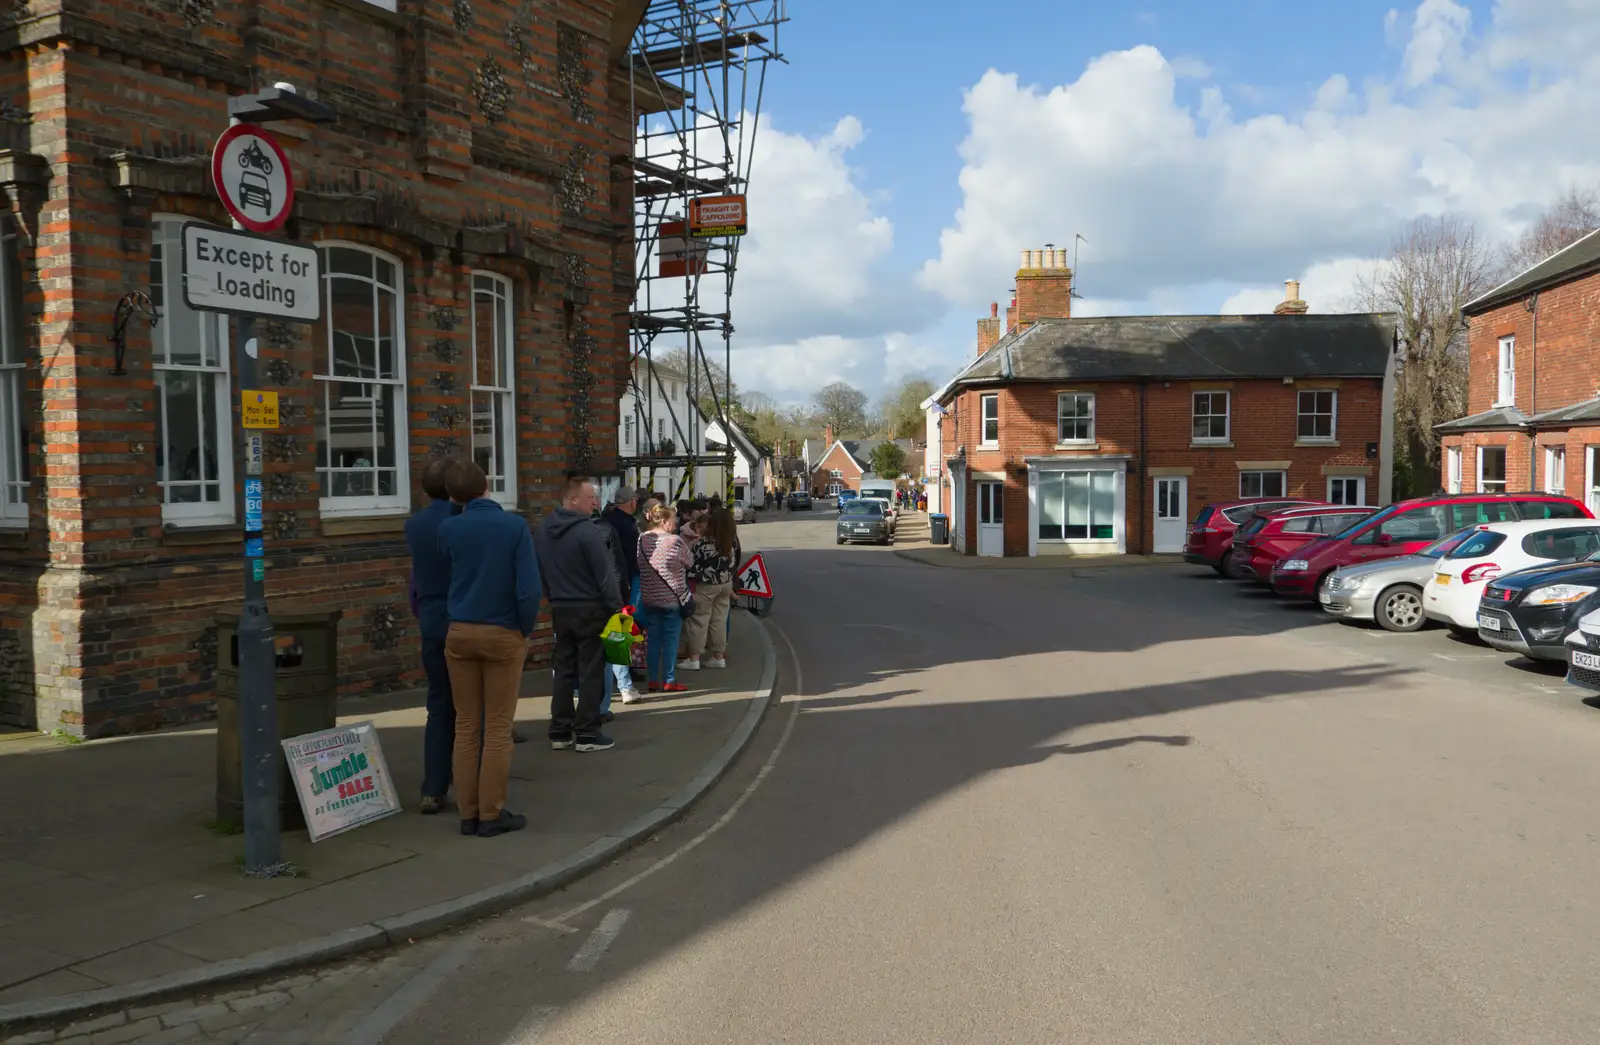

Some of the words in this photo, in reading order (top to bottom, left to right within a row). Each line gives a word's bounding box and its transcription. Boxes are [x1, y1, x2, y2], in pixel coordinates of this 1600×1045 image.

[196, 236, 274, 273] Except
[280, 253, 309, 278] for
[1576, 653, 1591, 666] EK23
[309, 752, 369, 796] Jumble
[337, 775, 374, 799] SALE
